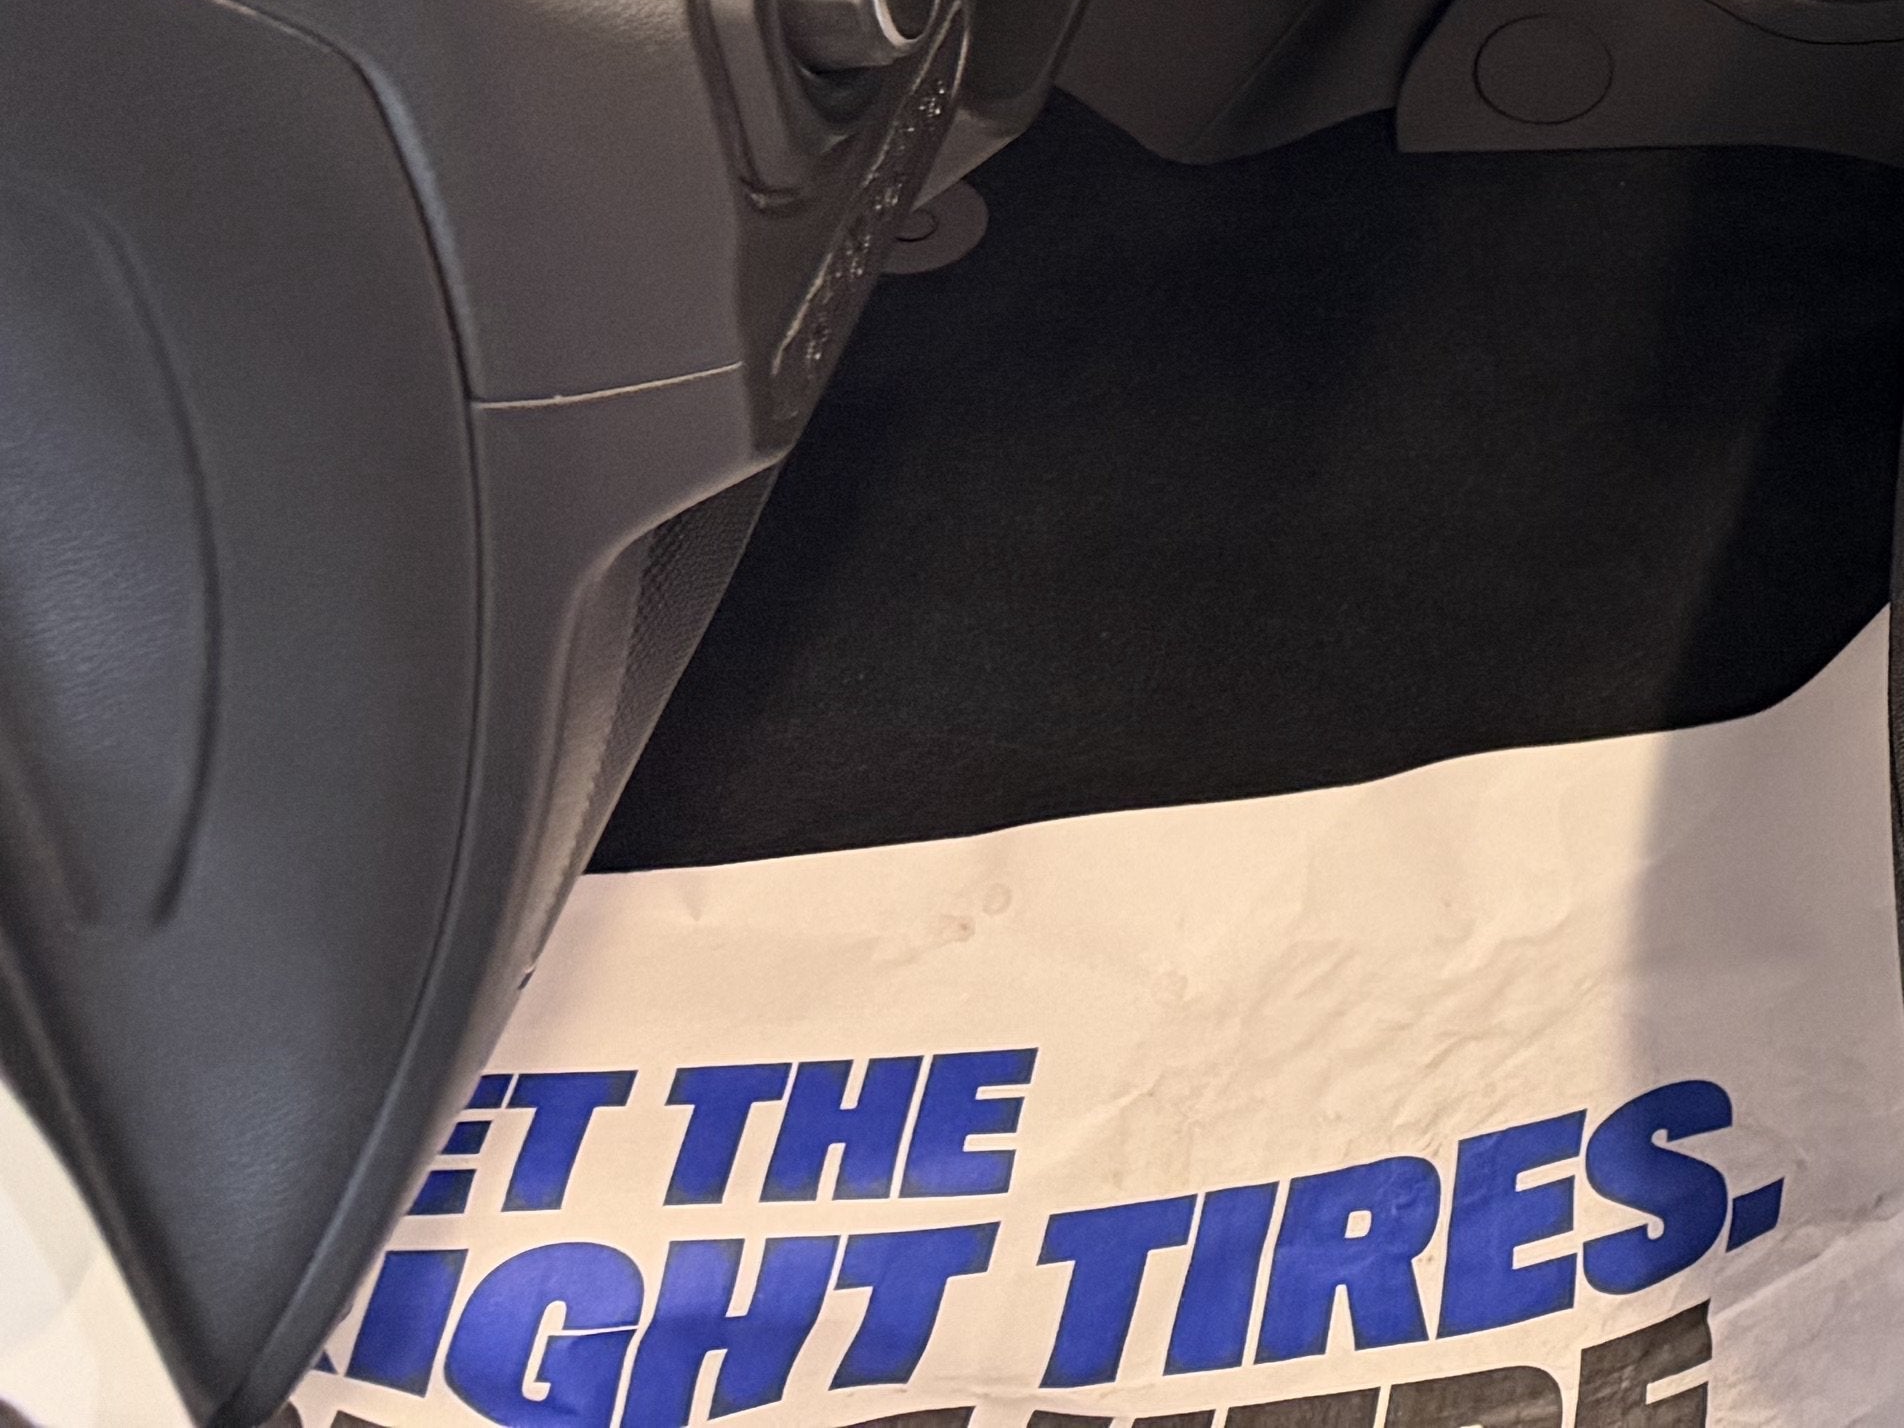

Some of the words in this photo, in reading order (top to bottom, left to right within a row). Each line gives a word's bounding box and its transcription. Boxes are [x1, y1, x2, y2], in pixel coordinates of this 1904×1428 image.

[664, 1048, 1038, 1205] THE
[310, 1222, 998, 1428] IGHT
[1036, 1080, 1784, 1388] TIRES.
